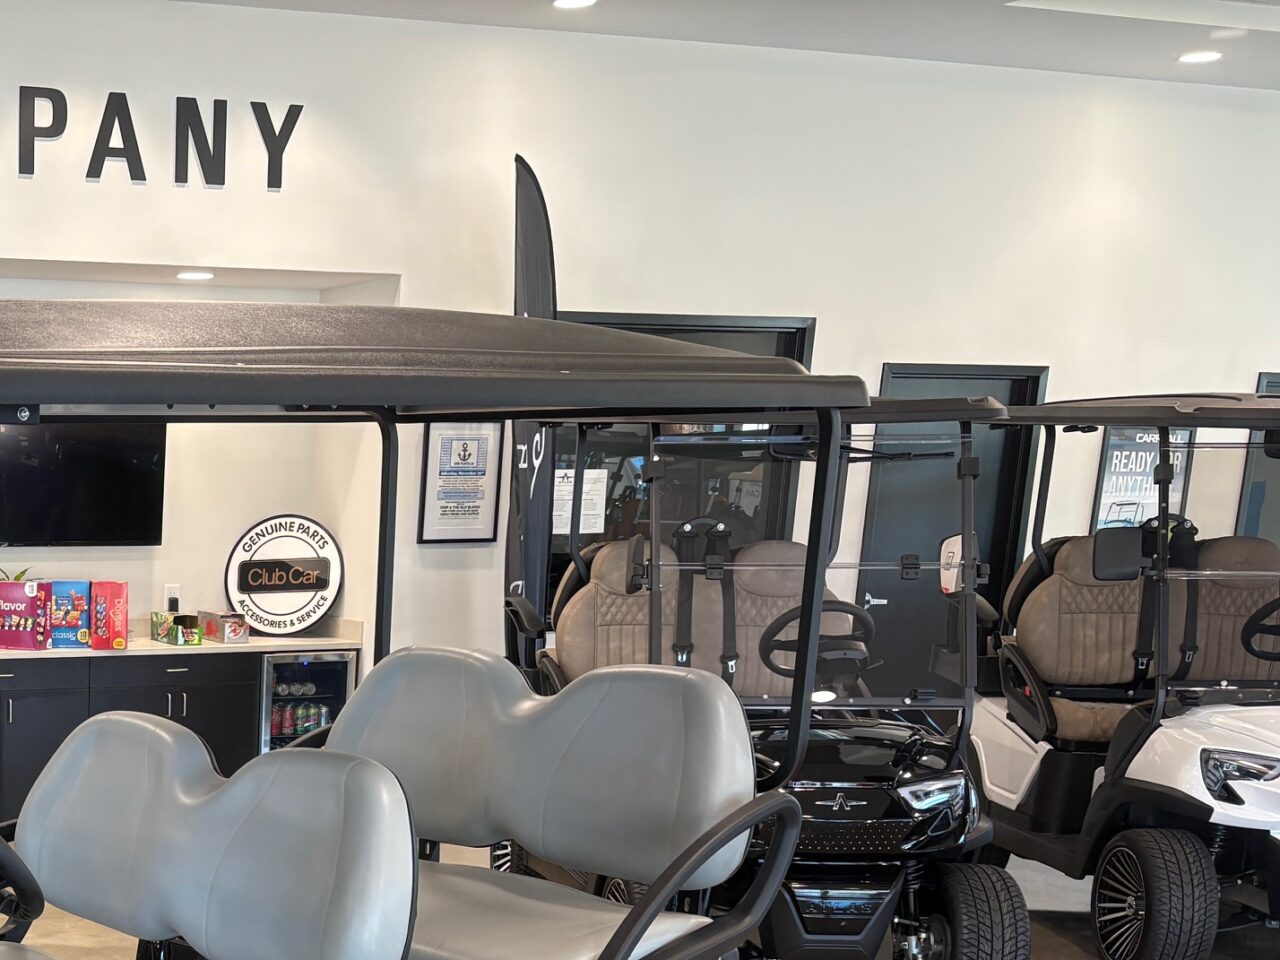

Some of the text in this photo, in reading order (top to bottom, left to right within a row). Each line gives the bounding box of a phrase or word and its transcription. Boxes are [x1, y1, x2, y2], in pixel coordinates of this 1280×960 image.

[1111, 451, 1155, 473] READY
[242, 521, 329, 553] GENUINE PARTS
[248, 566, 320, 586] Club Car
[237, 594, 329, 629] ACCESSORIES & SERVICE
[52, 631, 76, 640] classic
